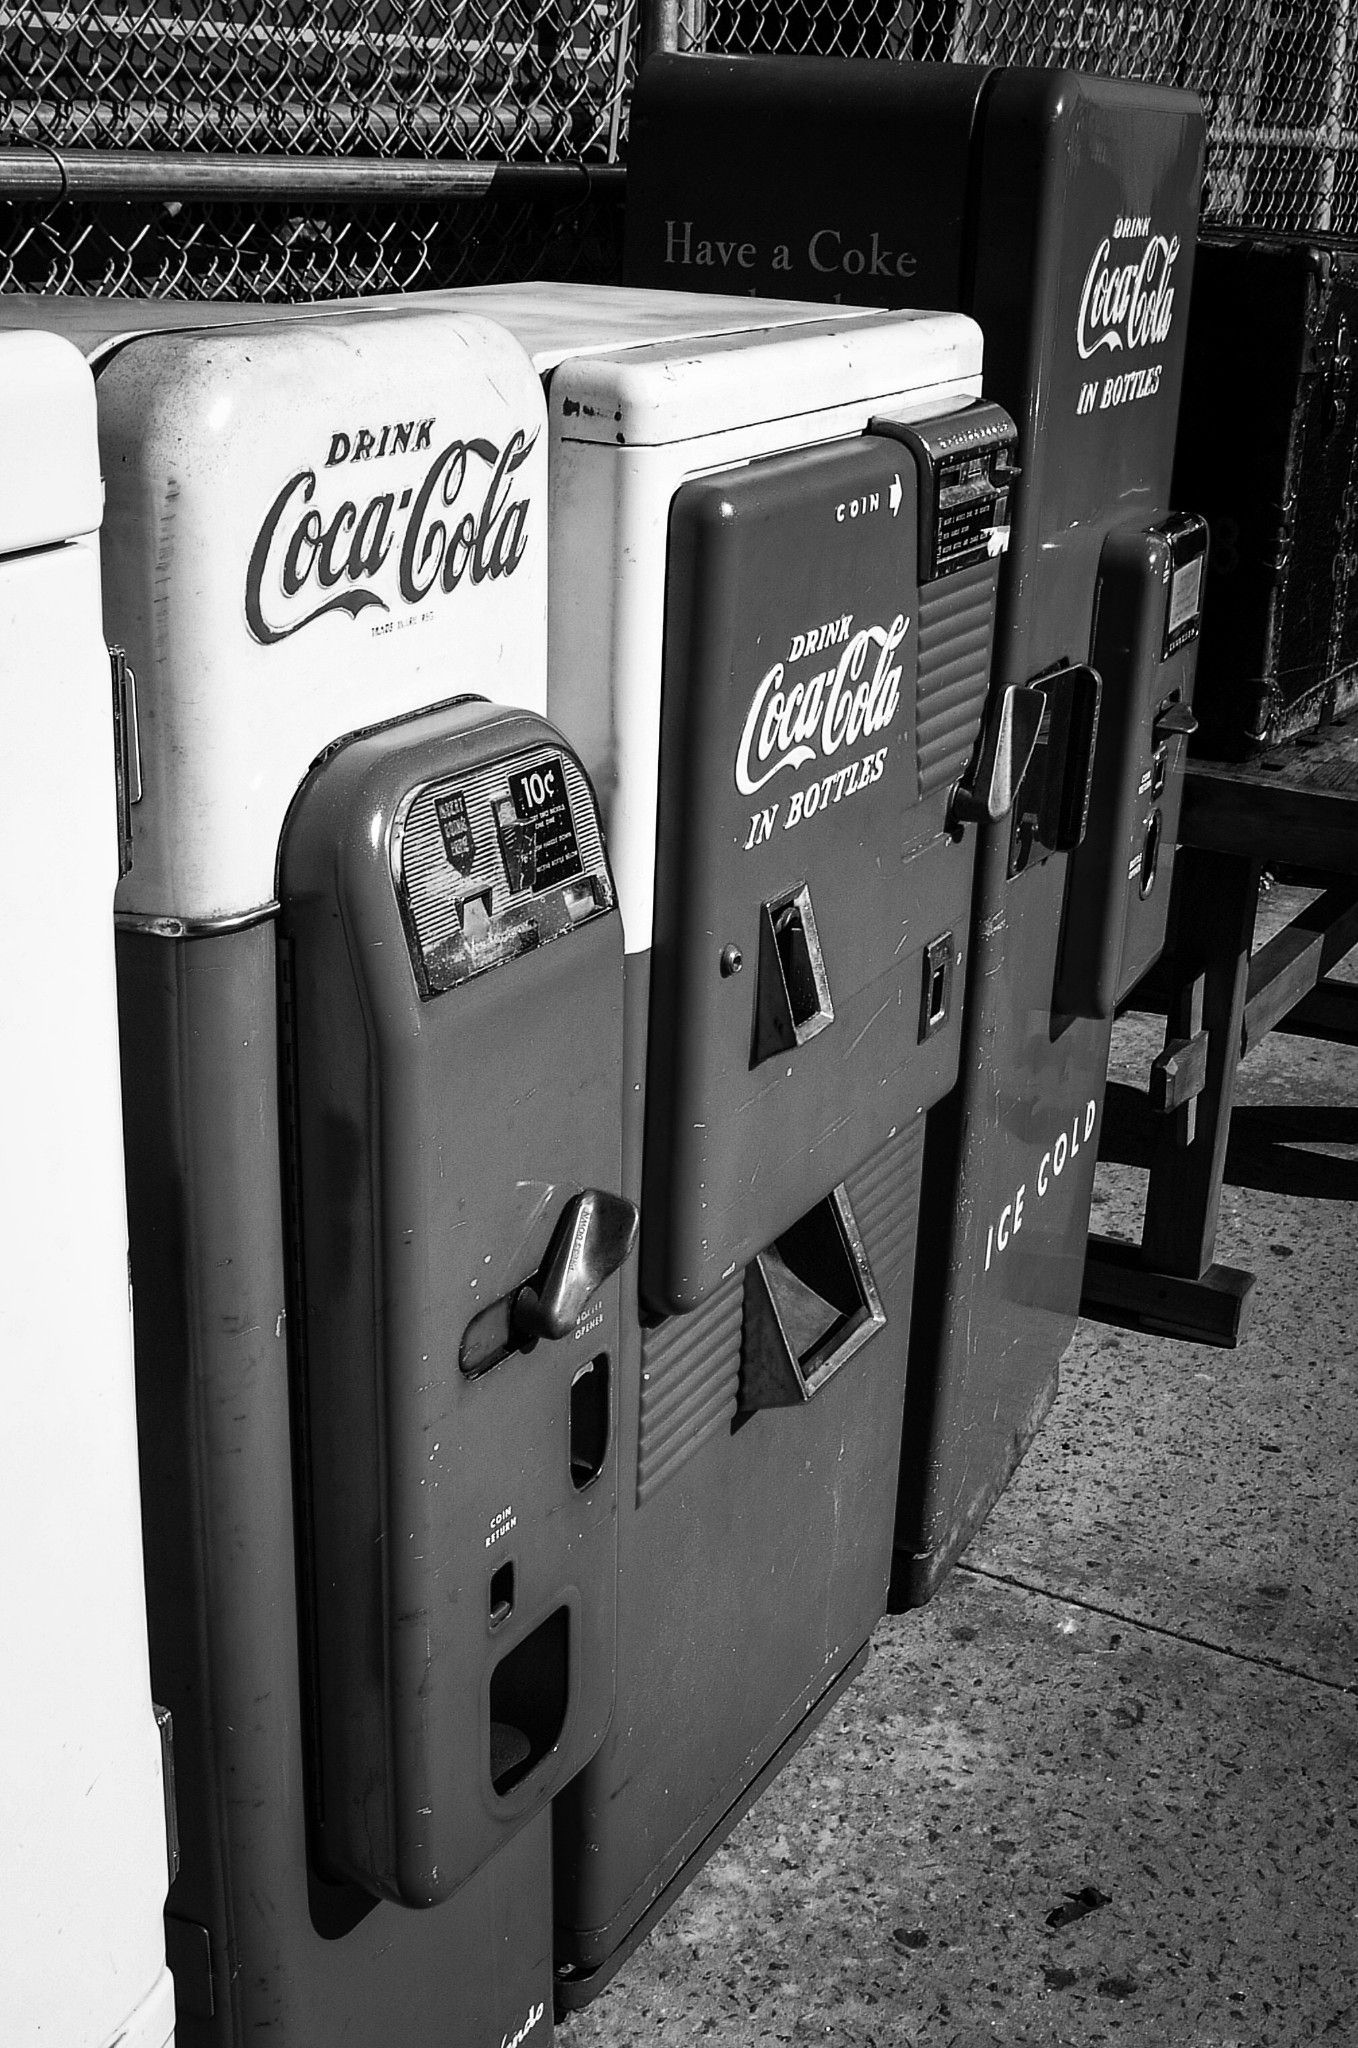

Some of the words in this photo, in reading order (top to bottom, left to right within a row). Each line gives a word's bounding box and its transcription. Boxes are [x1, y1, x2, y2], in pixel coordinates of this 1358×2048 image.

[664, 220, 757, 268] Have
[771, 244, 793, 270] a
[808, 229, 917, 278] Coke
[1112, 217, 1151, 239] DRINK
[1076, 381, 1099, 415] IN
[1100, 365, 1163, 409] BOTTLES
[325, 417, 436, 468] DRINK
[835, 492, 880, 522] COIN
[786, 614, 853, 663] DRINK
[521, 769, 555, 808] 10¢
[743, 803, 780, 851] IN
[783, 746, 889, 830] BOTTLES
[984, 1183, 1026, 1272] ICE
[1038, 1099, 1096, 1197] COLD
[485, 1516, 517, 1548] RETURN
[490, 1505, 512, 1529] COIN
